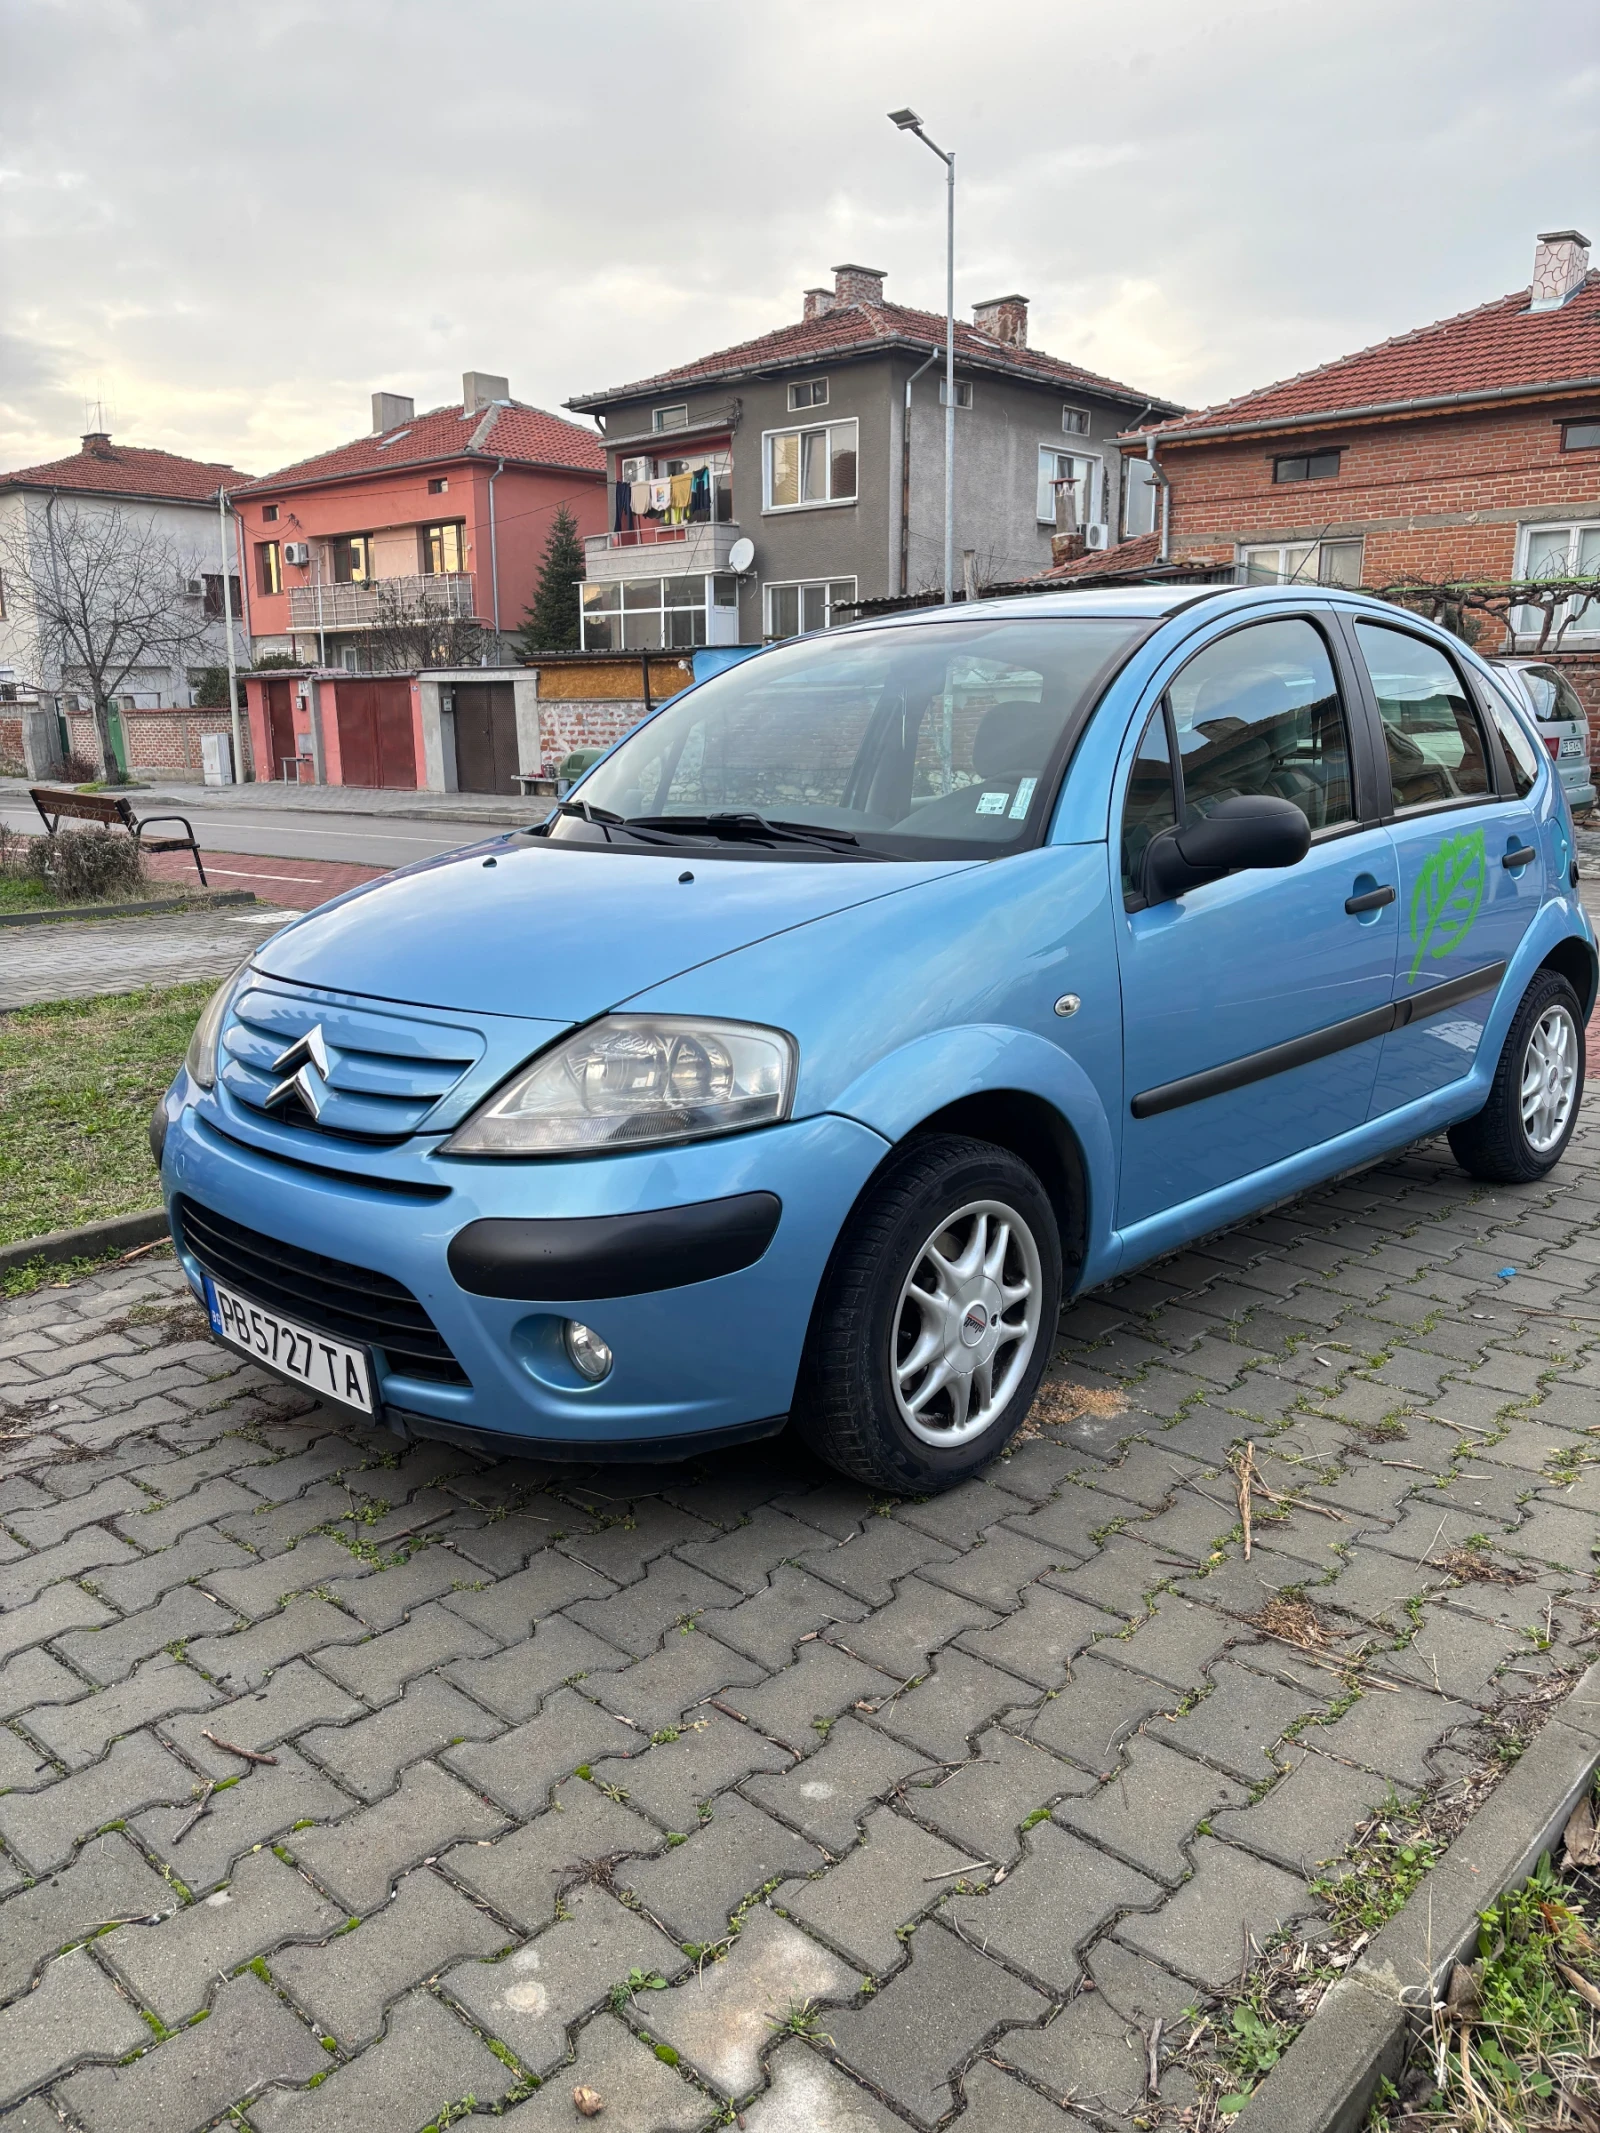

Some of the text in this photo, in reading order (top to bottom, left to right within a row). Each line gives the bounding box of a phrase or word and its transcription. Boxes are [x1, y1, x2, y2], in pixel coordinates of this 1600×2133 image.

[211, 1309, 221, 1326] BG
[217, 1290, 366, 1405] PB 5727 TA
